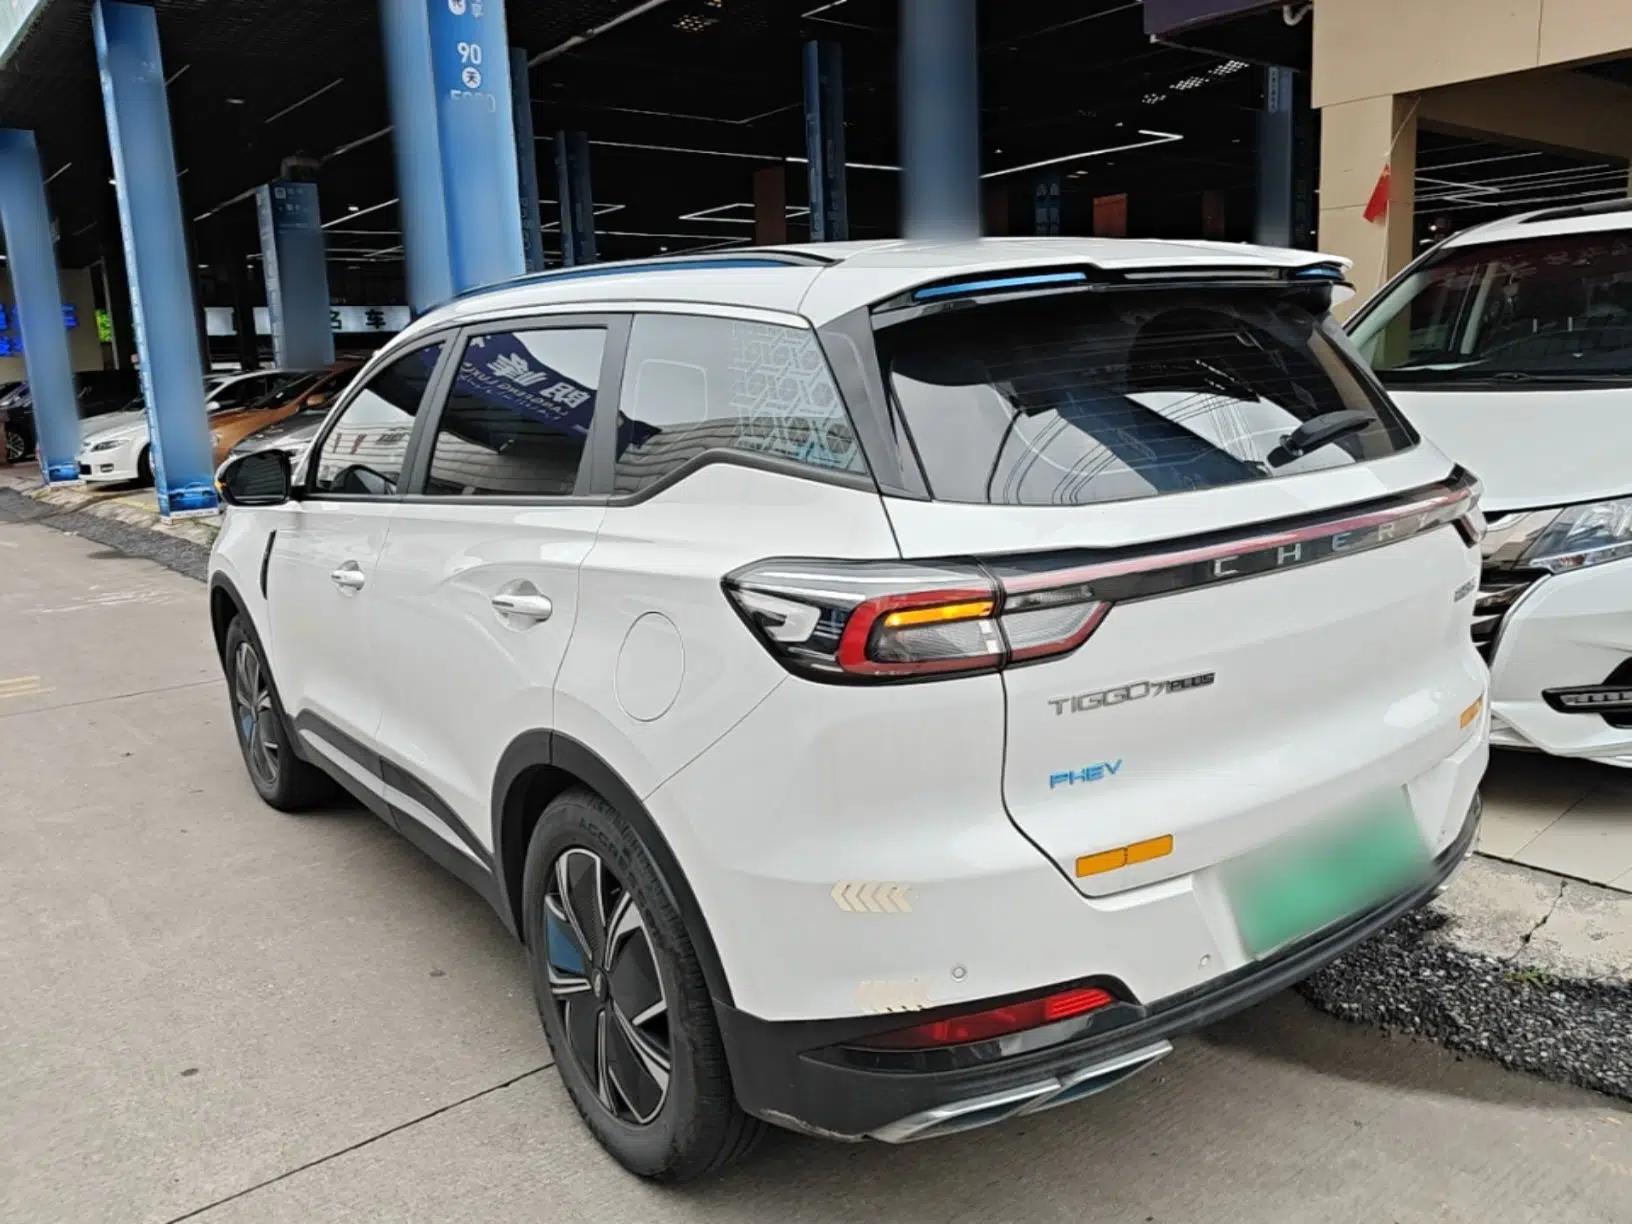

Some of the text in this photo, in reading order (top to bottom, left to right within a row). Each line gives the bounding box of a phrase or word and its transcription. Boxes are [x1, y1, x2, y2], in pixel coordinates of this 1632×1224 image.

[457, 42, 482, 65] 90
[1213, 513, 1429, 578] CHERY
[1049, 758, 1123, 789] PHEV
